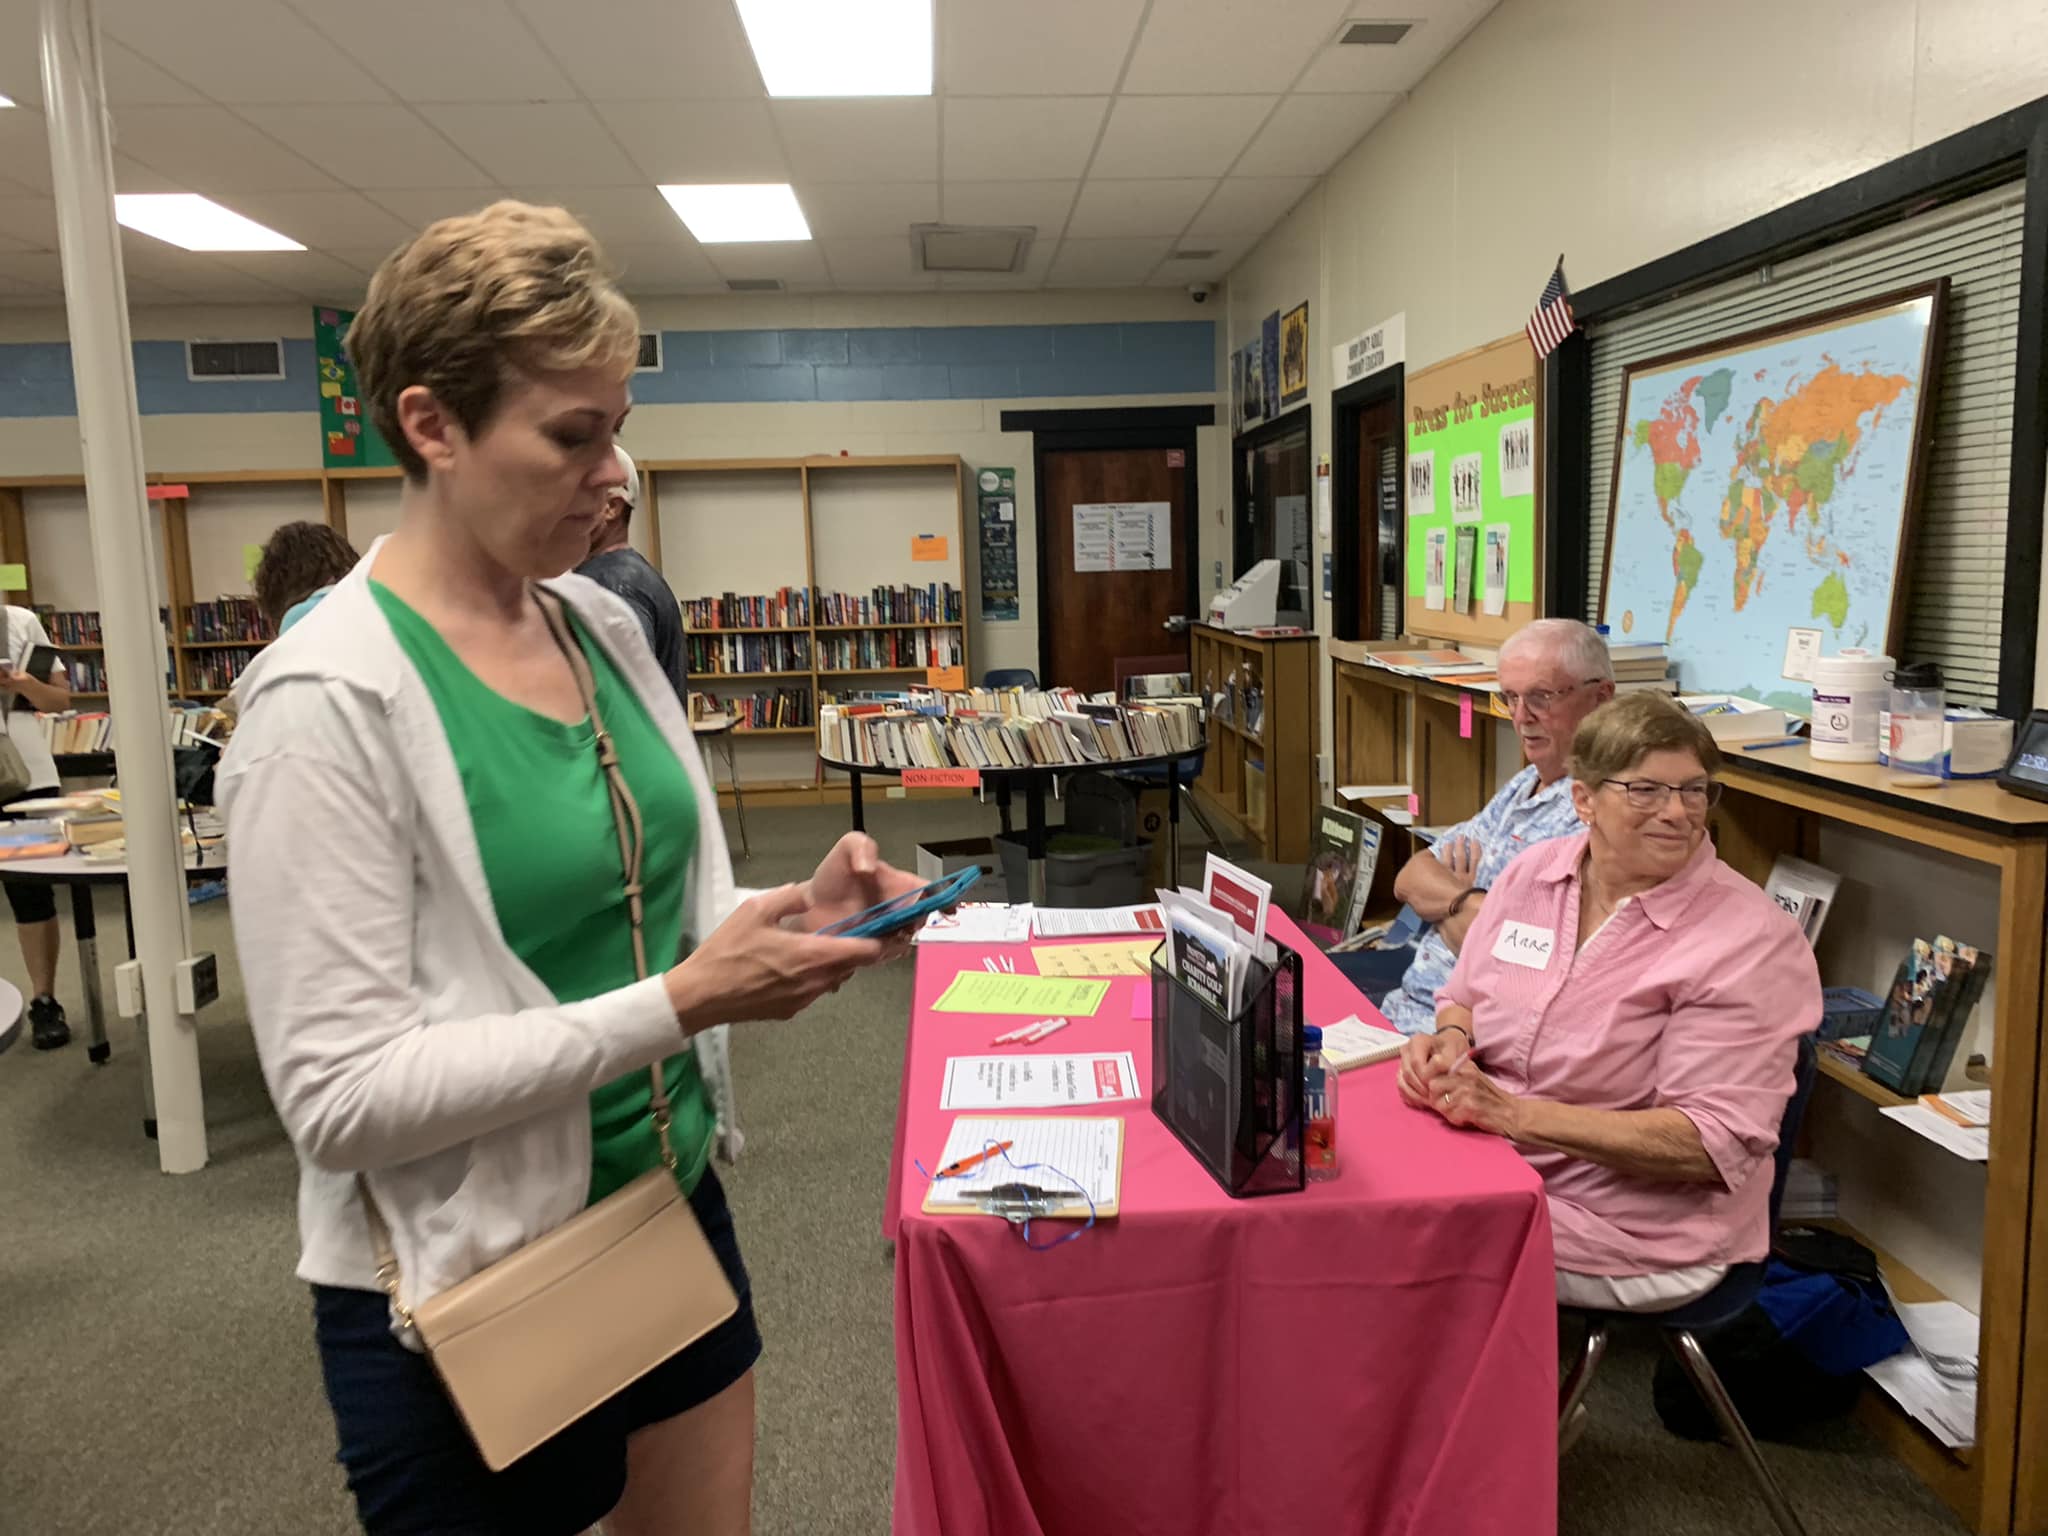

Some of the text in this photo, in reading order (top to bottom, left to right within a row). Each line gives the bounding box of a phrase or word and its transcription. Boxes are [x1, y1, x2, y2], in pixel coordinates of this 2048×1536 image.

[1413, 379, 1536, 436] Dress for Success
[905, 773, 965, 784] NON-FICTION
[1503, 928, 1550, 953] Anne
[1182, 957, 1206, 985] CHARITY
[1206, 975, 1223, 996] GOLF
